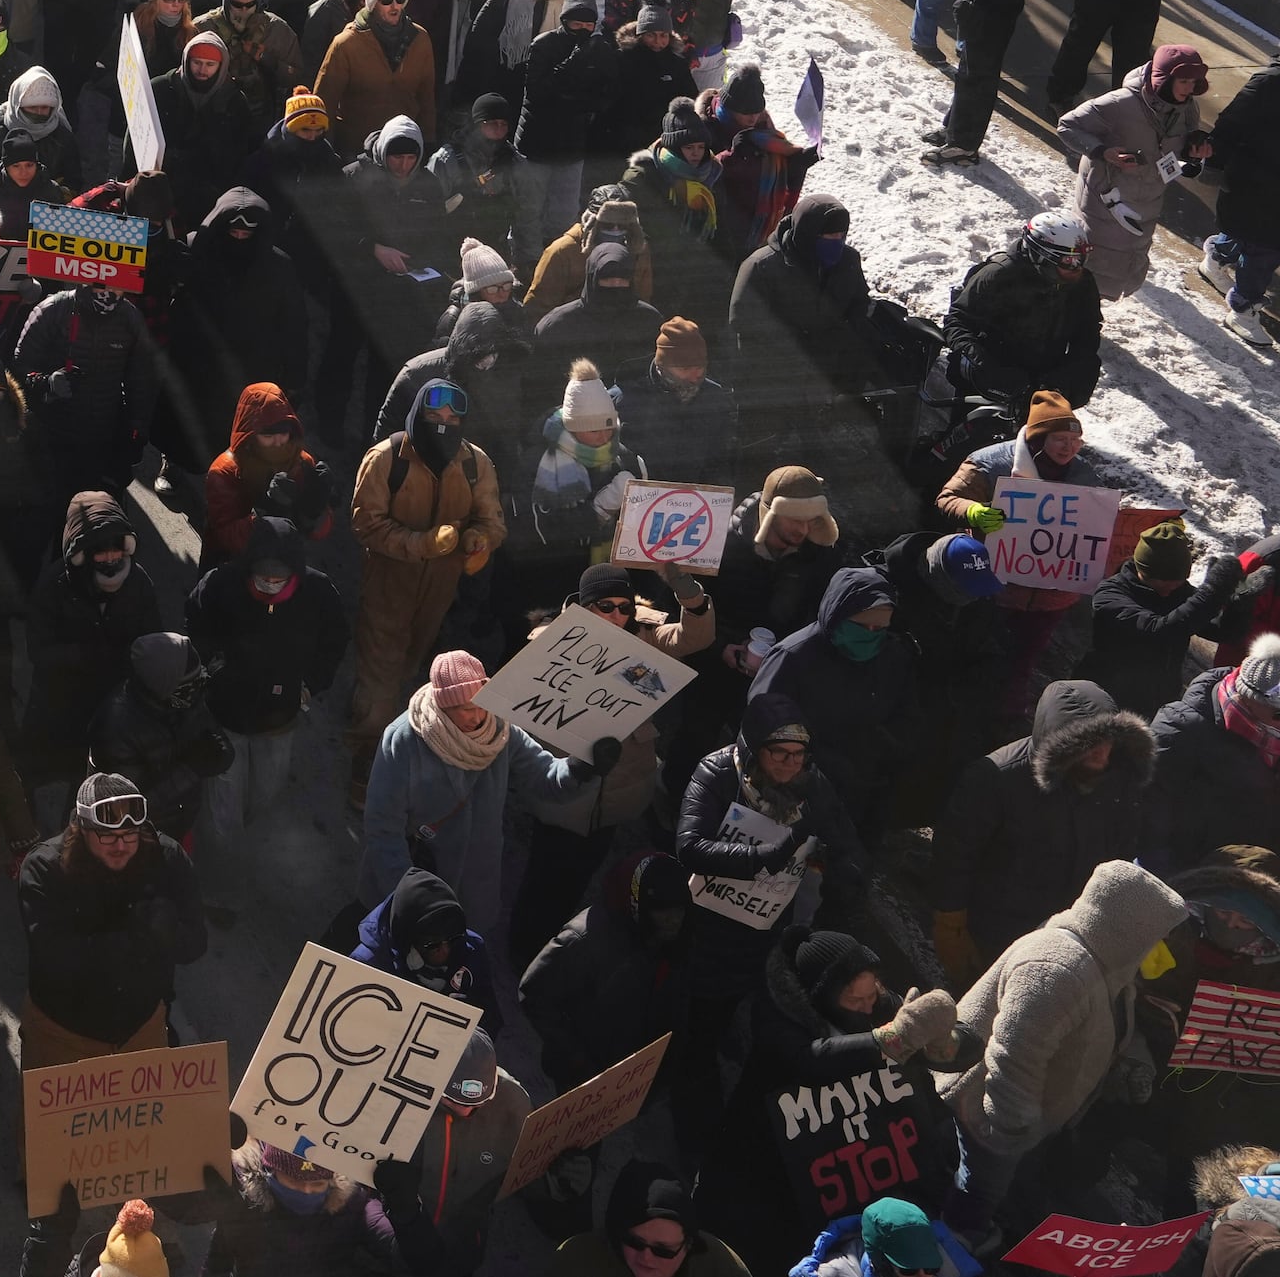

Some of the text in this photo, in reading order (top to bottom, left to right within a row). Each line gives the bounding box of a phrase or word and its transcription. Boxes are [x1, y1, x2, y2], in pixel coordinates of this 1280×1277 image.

[284, 959, 471, 1098] ICE
[253, 1098, 318, 1134] for
[264, 1052, 431, 1145] OUT
[777, 1063, 915, 1142] MAKE
[842, 1109, 871, 1144] IT
[809, 1116, 920, 1217] STOP
[1036, 1226, 1193, 1254] ABOLISH
[1074, 1250, 1133, 1270] ICE
